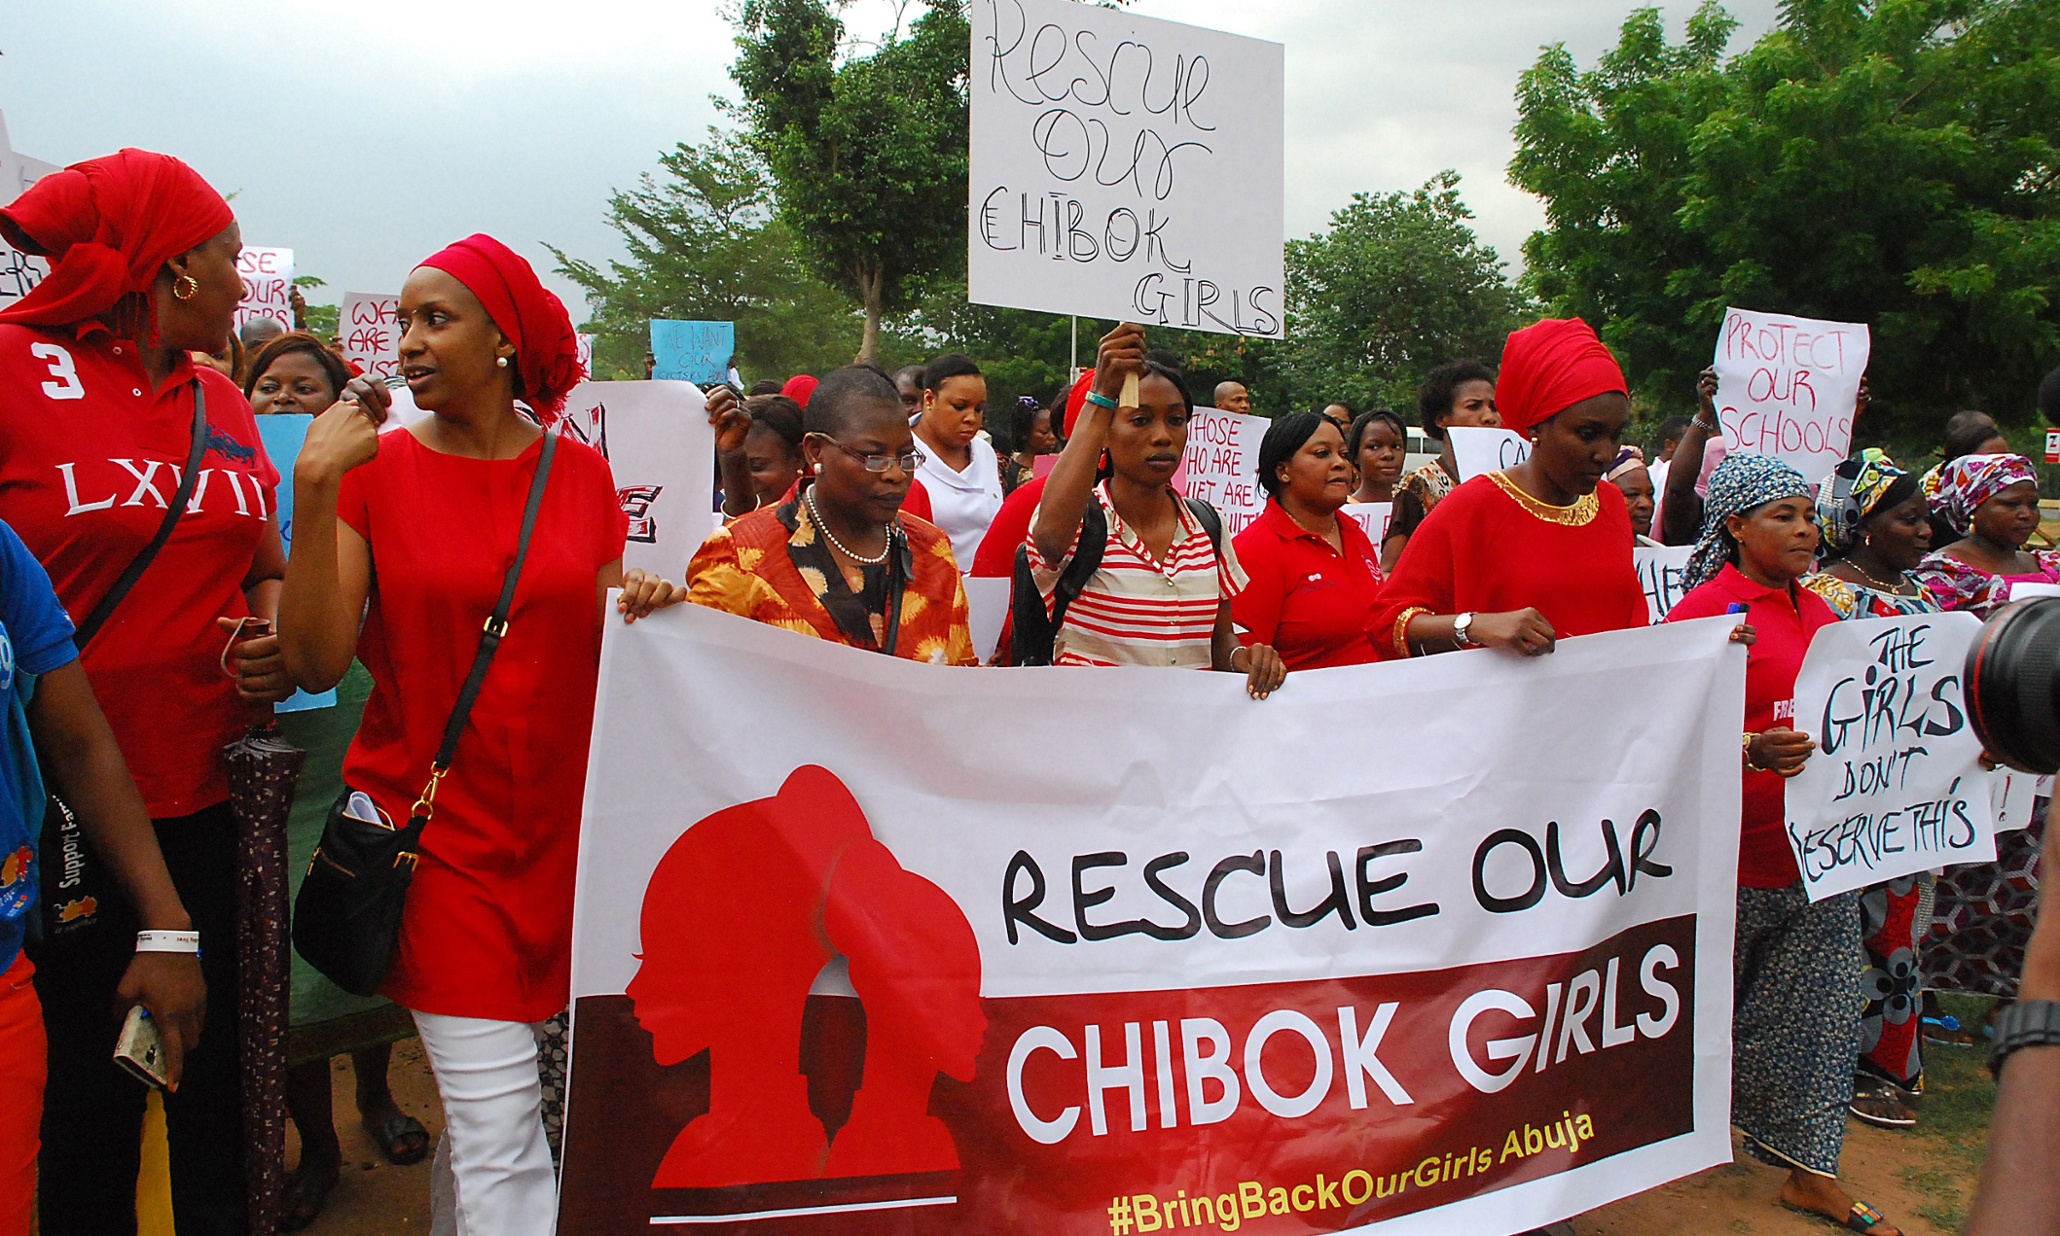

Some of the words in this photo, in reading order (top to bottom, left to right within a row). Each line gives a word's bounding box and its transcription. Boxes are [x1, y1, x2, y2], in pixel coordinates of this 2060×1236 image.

[1133, 272, 1280, 336] GIRLS
[348, 326, 391, 356] ARE
[678, 351, 716, 370] OUR
[1727, 313, 1851, 375] PROTECT
[31, 341, 86, 400] 3
[1747, 367, 1817, 412] OUR
[1188, 413, 1242, 447] THOSE
[1719, 406, 1852, 460] SCHOOLS
[1210, 447, 1243, 477] ARE
[1222, 481, 1254, 507] ARE
[1869, 624, 1934, 674] THE
[1833, 746, 1929, 803] DON'T
[58, 831, 85, 889] Support
[1000, 838, 1440, 945] RESCUE
[1471, 808, 1672, 914] OUR
[1006, 1001, 1415, 1144] CHIBOK
[1448, 943, 1681, 1094] GIRLS
[1107, 1146, 1493, 1236] #BringBackOurGirls
[1499, 1110, 1595, 1164] Abuja
